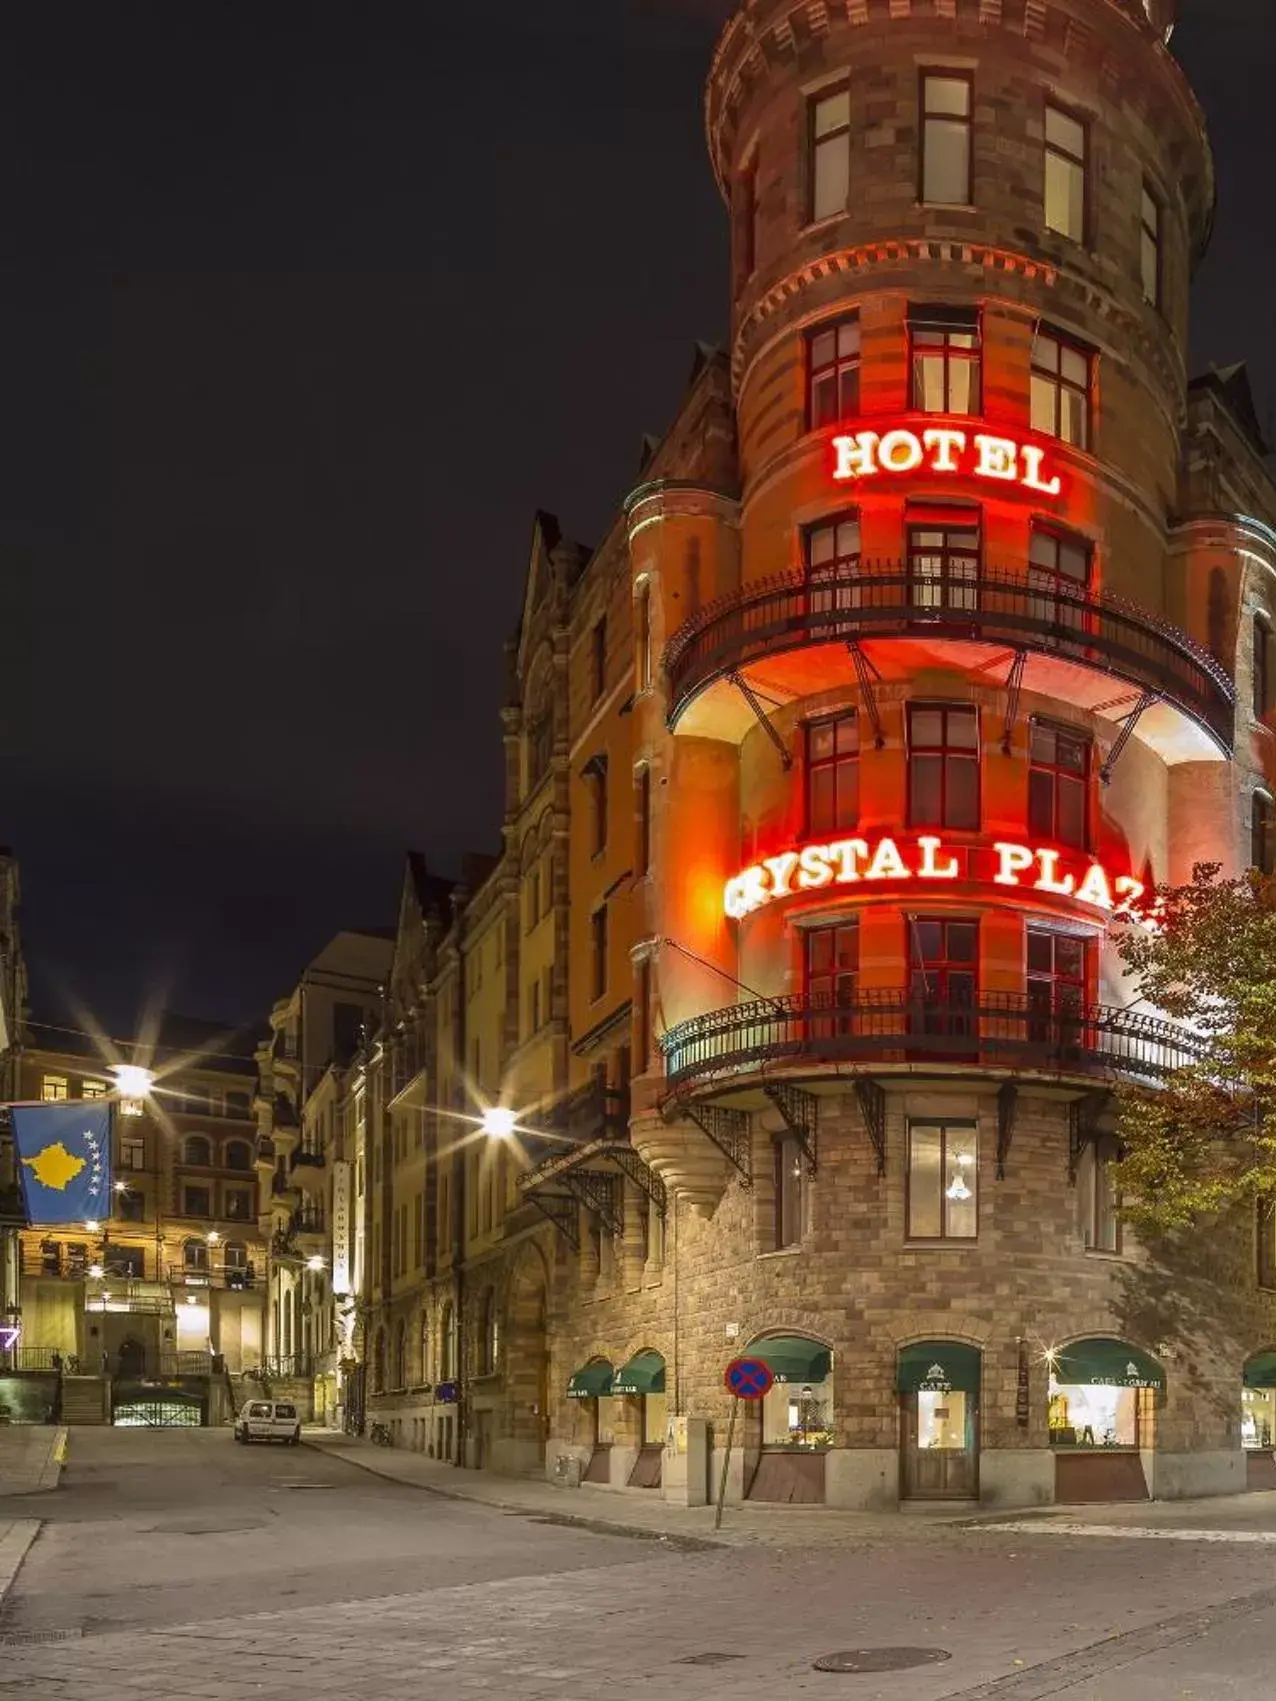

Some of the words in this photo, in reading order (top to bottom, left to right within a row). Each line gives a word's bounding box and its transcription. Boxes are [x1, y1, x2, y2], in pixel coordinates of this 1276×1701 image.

[832, 429, 1061, 494] HOTEL
[724, 837, 958, 917] CRYSTAL
[995, 842, 1167, 931] PLAZ
